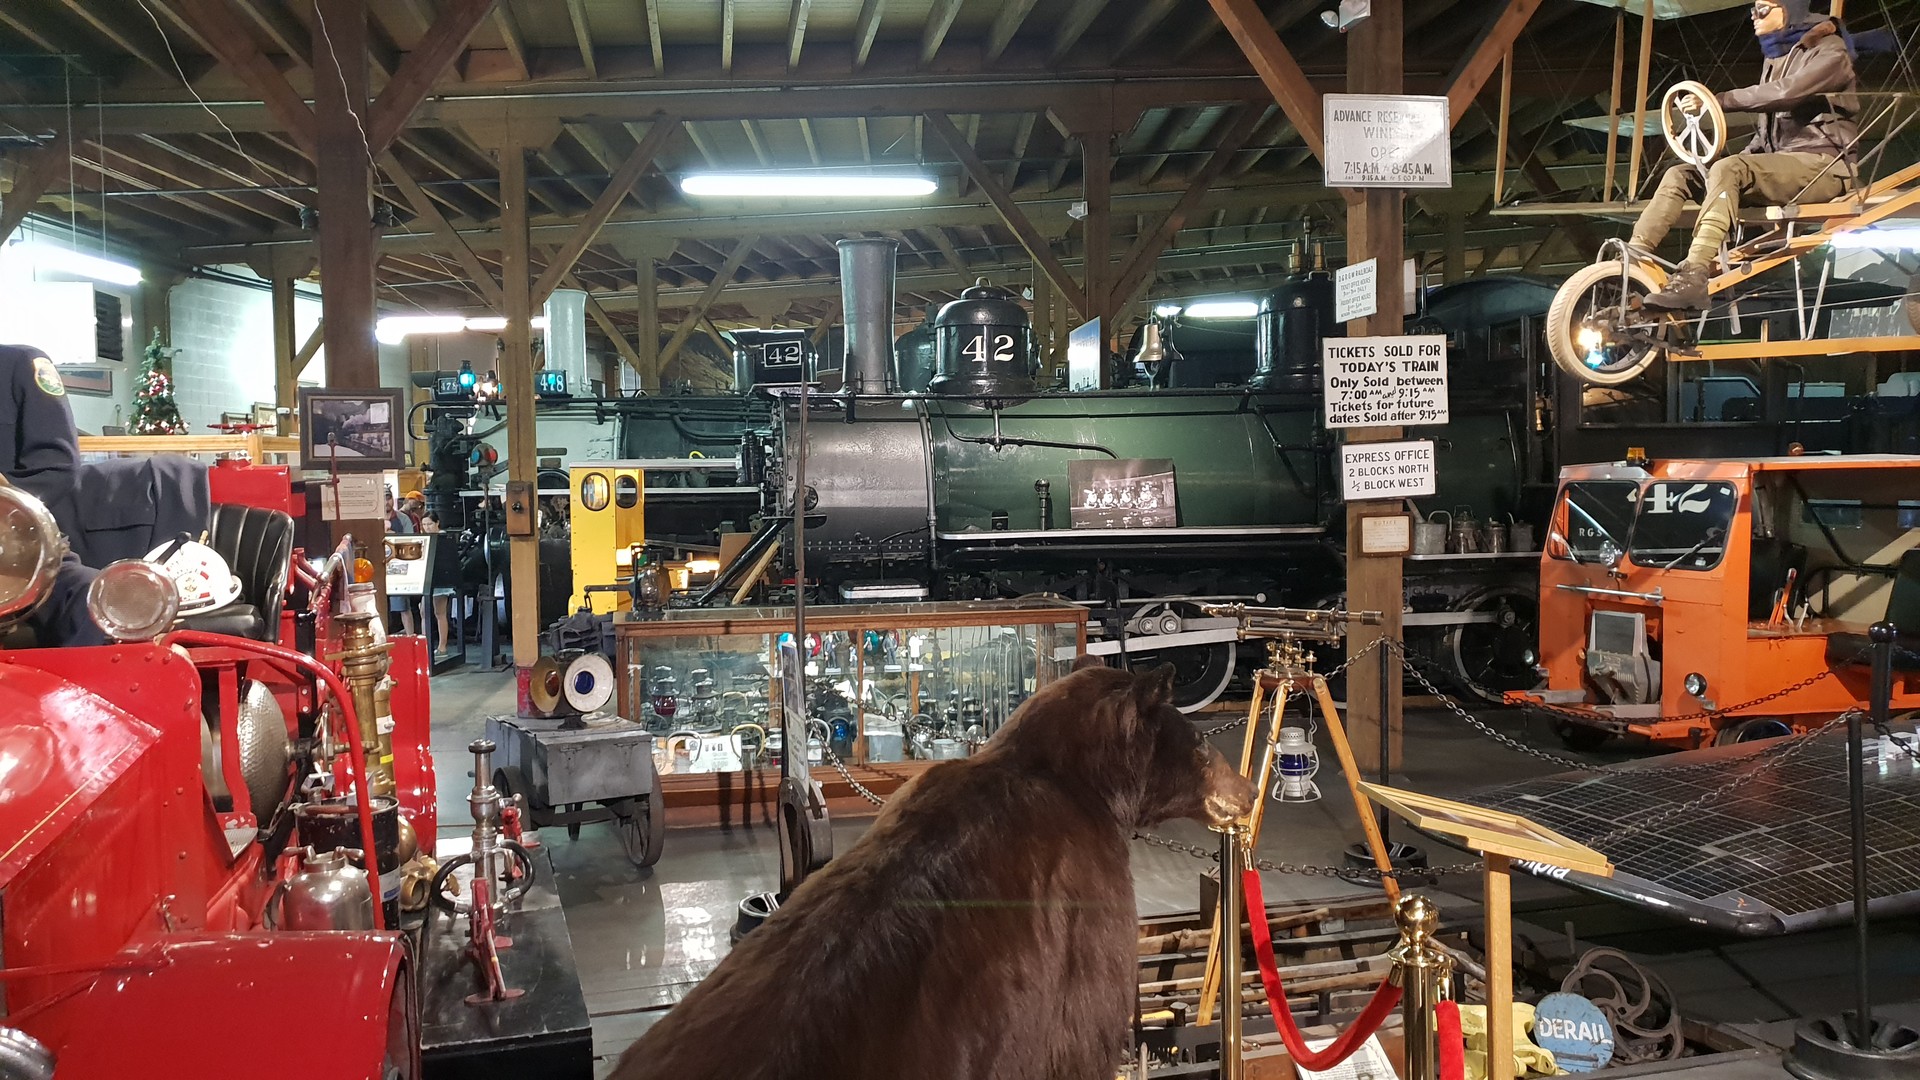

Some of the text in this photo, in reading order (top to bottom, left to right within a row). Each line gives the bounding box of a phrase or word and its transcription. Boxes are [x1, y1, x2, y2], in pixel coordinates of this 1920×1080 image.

[1334, 110, 1372, 122] ADVANCE
[961, 334, 1014, 362] 42
[1328, 345, 1441, 358] TICKETS SOLD FOR
[768, 346, 799, 364] 42
[1340, 360, 1439, 373] TODAY'S TRAIN
[441, 380, 457, 391] 478
[1330, 376, 1444, 390] Only Sold between
[1341, 390, 1367, 400] 7:00
[1382, 386, 1396, 399] and
[1399, 387, 1420, 399] 9:15
[1330, 400, 1434, 412] Tickets for future
[1329, 414, 1360, 423] dates
[1364, 412, 1387, 422] Sold
[1390, 410, 1416, 421] after
[1345, 449, 1430, 463] EXPRESS OFFICE
[1349, 464, 1429, 477] 2 BLOCKS NORTH
[1364, 480, 1396, 490] BLOCK
[1398, 478, 1424, 487] WEST
[1626, 483, 1711, 514] 42
[1540, 1017, 1614, 1044] DERAIL
